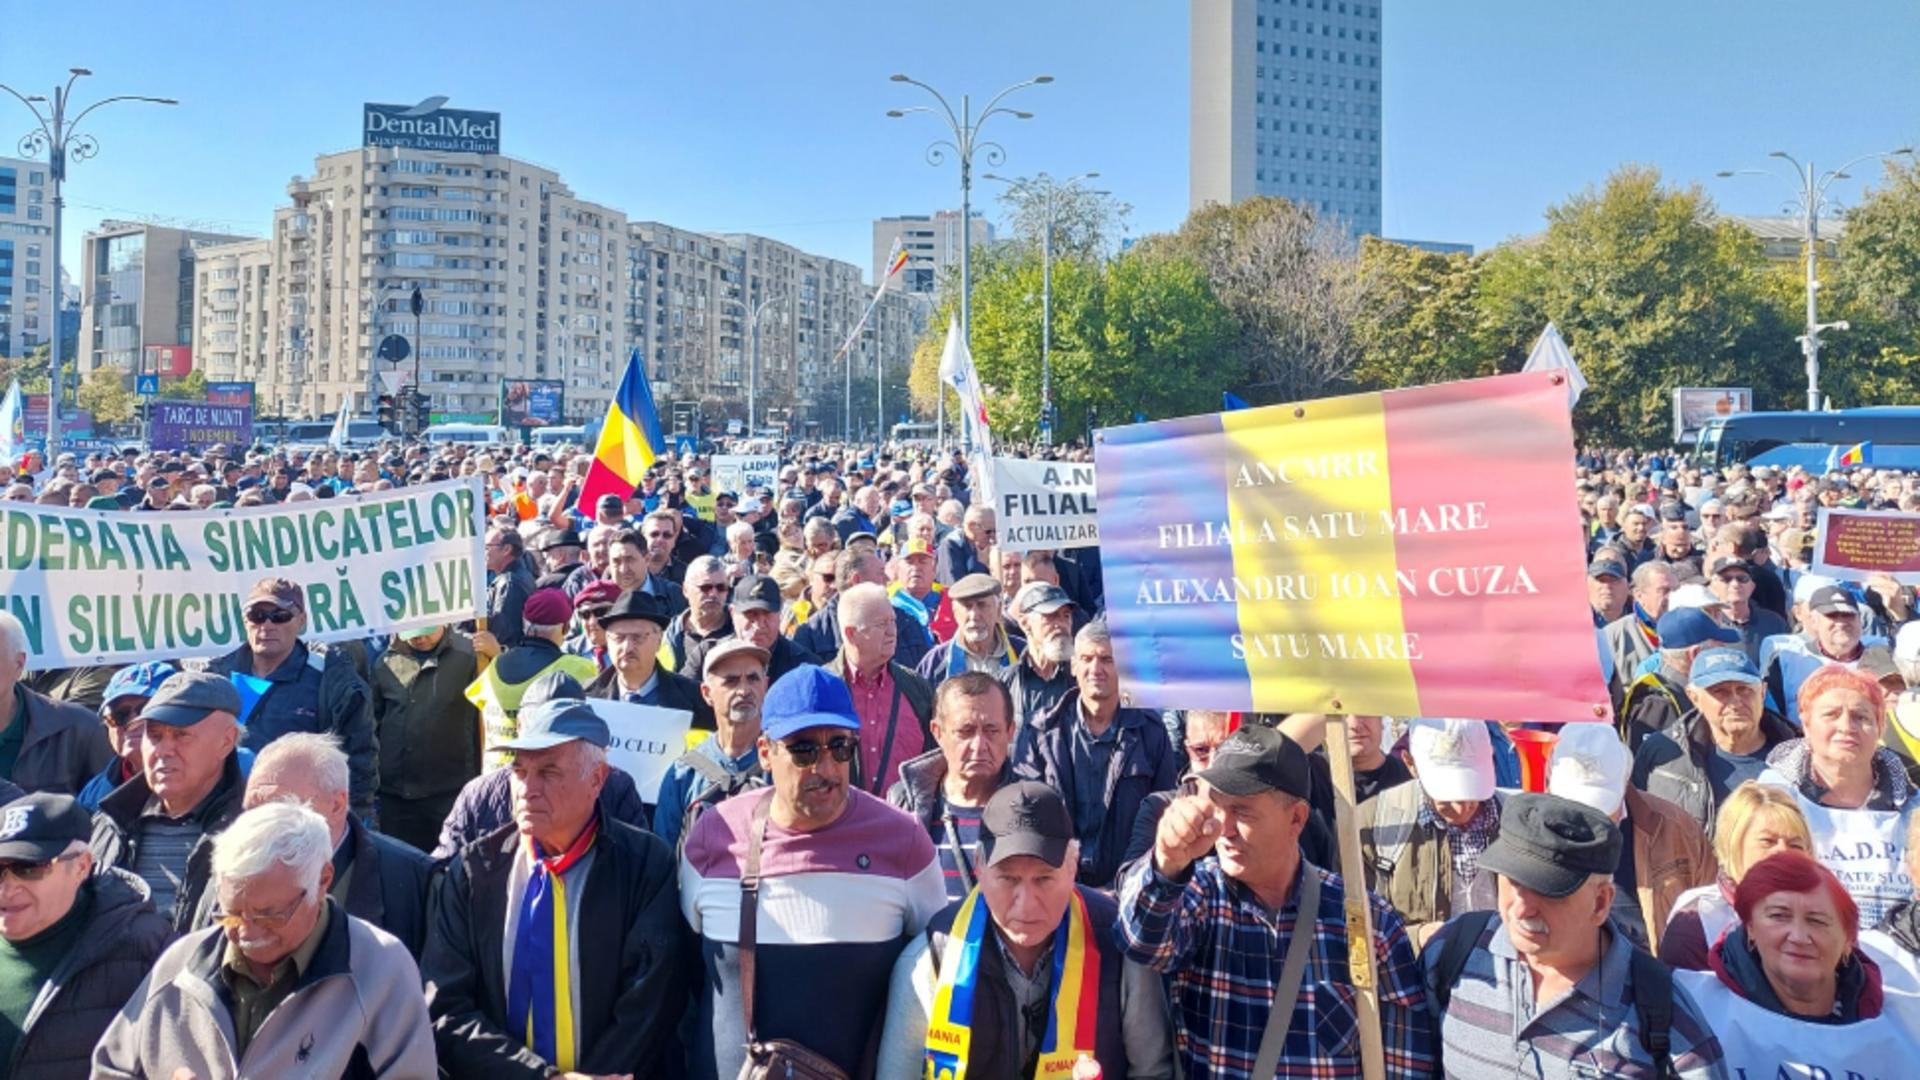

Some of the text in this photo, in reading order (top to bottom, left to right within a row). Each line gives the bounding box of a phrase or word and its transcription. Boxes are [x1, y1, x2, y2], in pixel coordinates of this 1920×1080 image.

[367, 111, 497, 140] DentalMed
[461, 139, 497, 152] Clinic
[195, 408, 208, 425] DE
[1042, 466, 1093, 486] A.N
[1234, 450, 1378, 488] ANCMRR
[1004, 492, 1097, 517] FILIAL
[0, 488, 477, 590] DERAȚIA SINDICATELOR
[1007, 523, 1097, 543] ACTUALIZAR
[1158, 501, 1489, 549] FILIALA SATU MARE
[1135, 564, 1540, 605] ALEXANDRU IOAN CUZA
[0, 594, 43, 655] N
[381, 558, 474, 621] SILVA
[1230, 631, 1424, 660] SATU MARE
[624, 739, 667, 755] CLUJ
